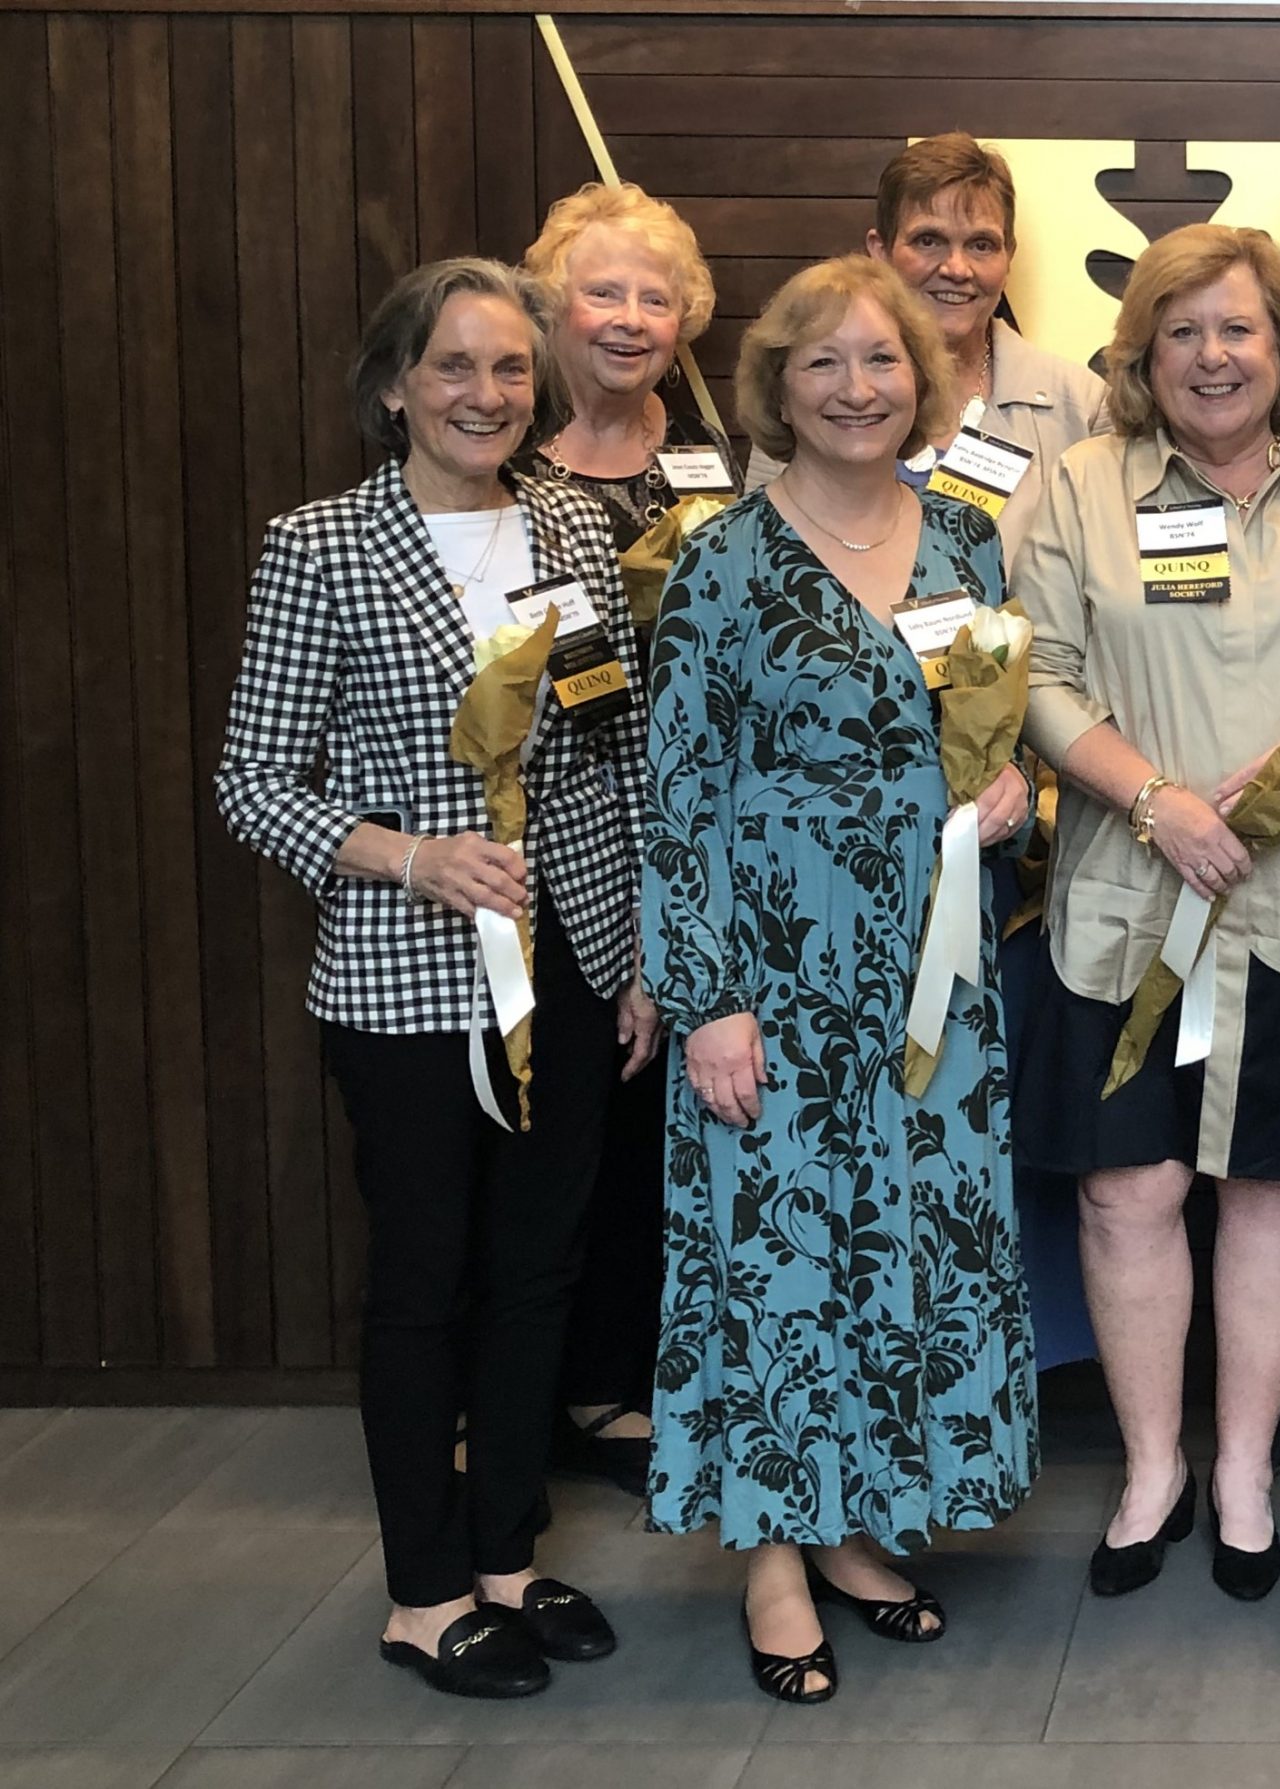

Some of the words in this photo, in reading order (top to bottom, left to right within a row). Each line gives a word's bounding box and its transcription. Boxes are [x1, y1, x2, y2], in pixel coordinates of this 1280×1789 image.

[941, 480, 989, 507] QUINQ
[1154, 560, 1211, 575] QUINQ
[1151, 583, 1176, 591] JULIA
[1177, 581, 1223, 590] HEREFORD
[1169, 590, 1207, 598] SOCIETY
[567, 670, 612, 695] QUINQ
